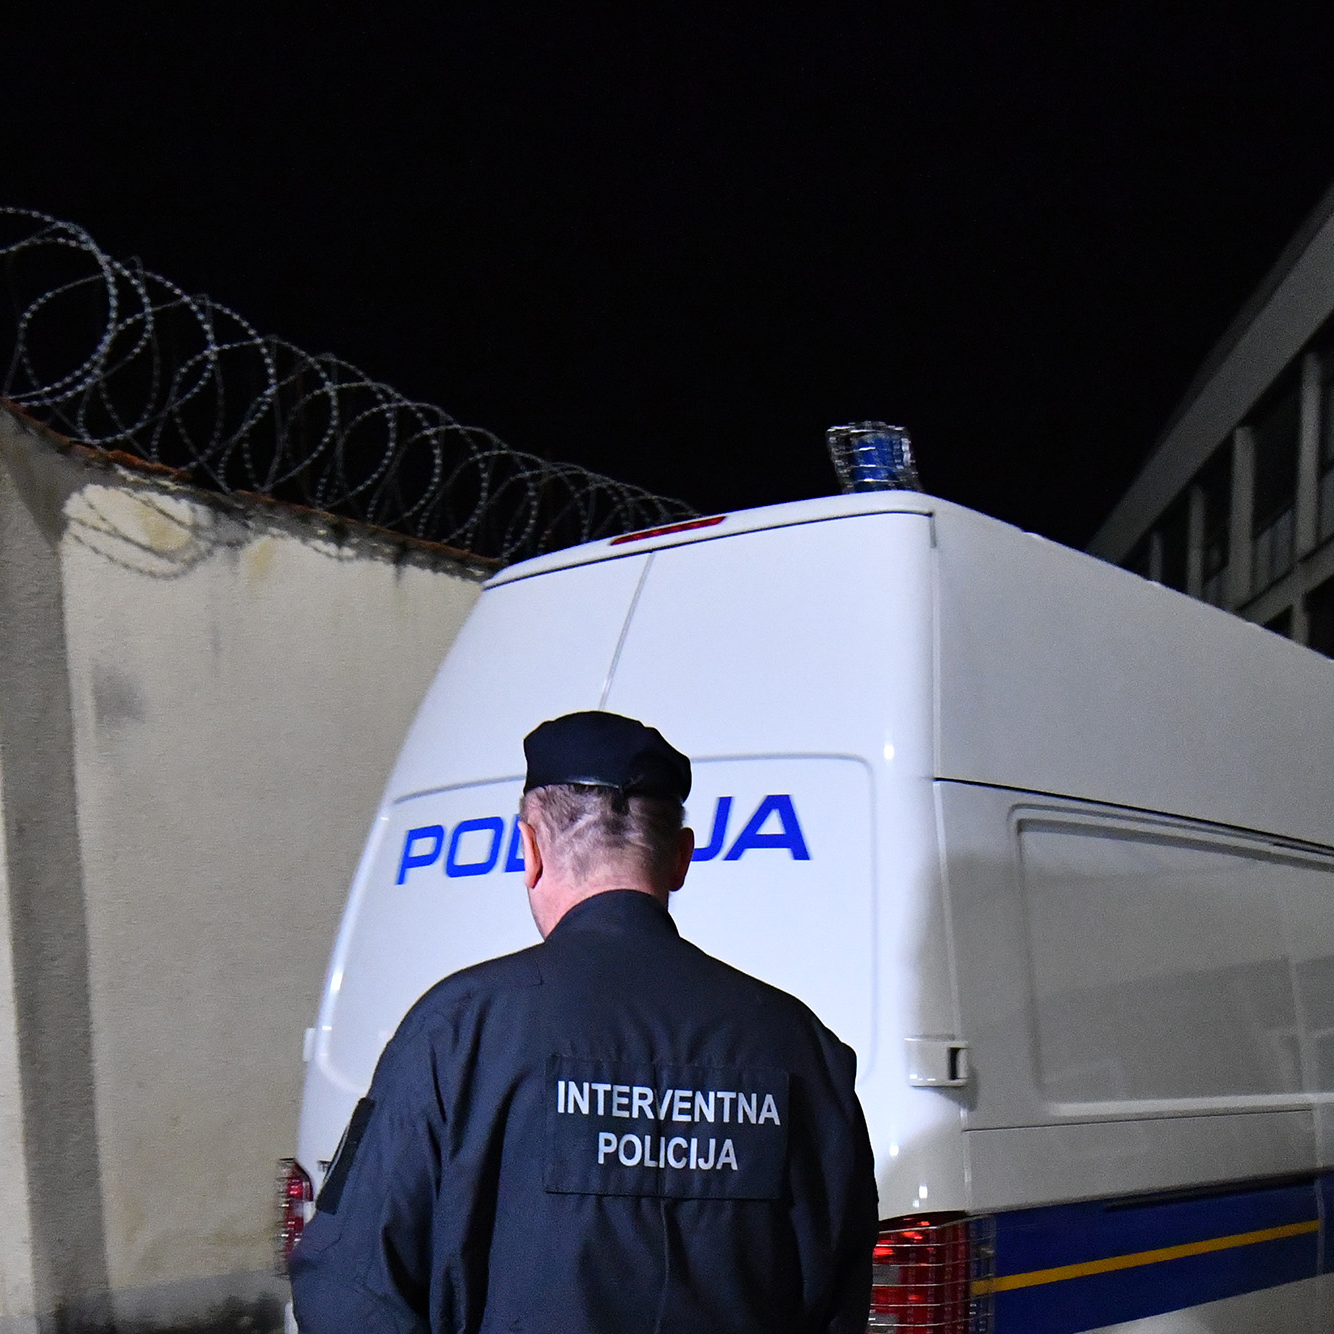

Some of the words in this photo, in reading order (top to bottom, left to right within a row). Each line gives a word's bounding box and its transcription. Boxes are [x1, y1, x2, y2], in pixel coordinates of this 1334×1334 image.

[395, 794, 811, 885] POLJA
[557, 1080, 781, 1126] INTERVENTNA
[597, 1131, 738, 1171] POLICIJA
